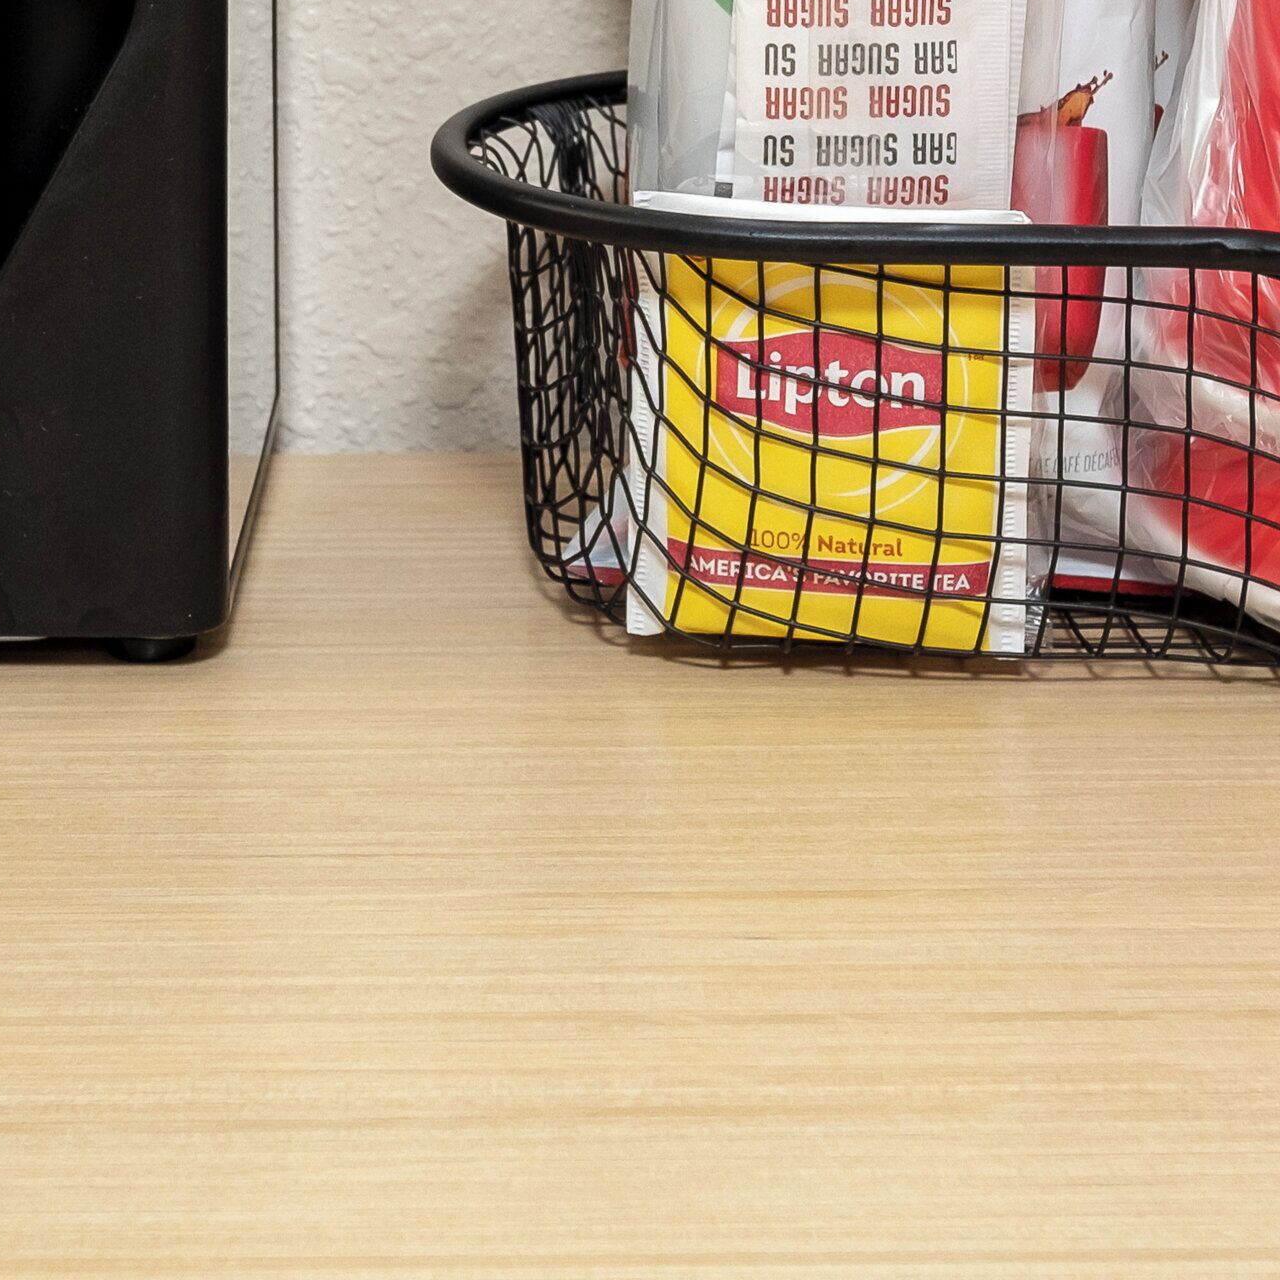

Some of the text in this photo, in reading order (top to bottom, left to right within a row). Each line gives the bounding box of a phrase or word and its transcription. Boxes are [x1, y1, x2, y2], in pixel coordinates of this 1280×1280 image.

[764, 40, 959, 77] GAR SUGAR SU
[765, 84, 952, 121] SUGAR SUGAR
[763, 131, 958, 168] GAR SUGAR SU
[763, 174, 950, 206] SUGAR SUGAR
[736, 351, 926, 415] Lipton
